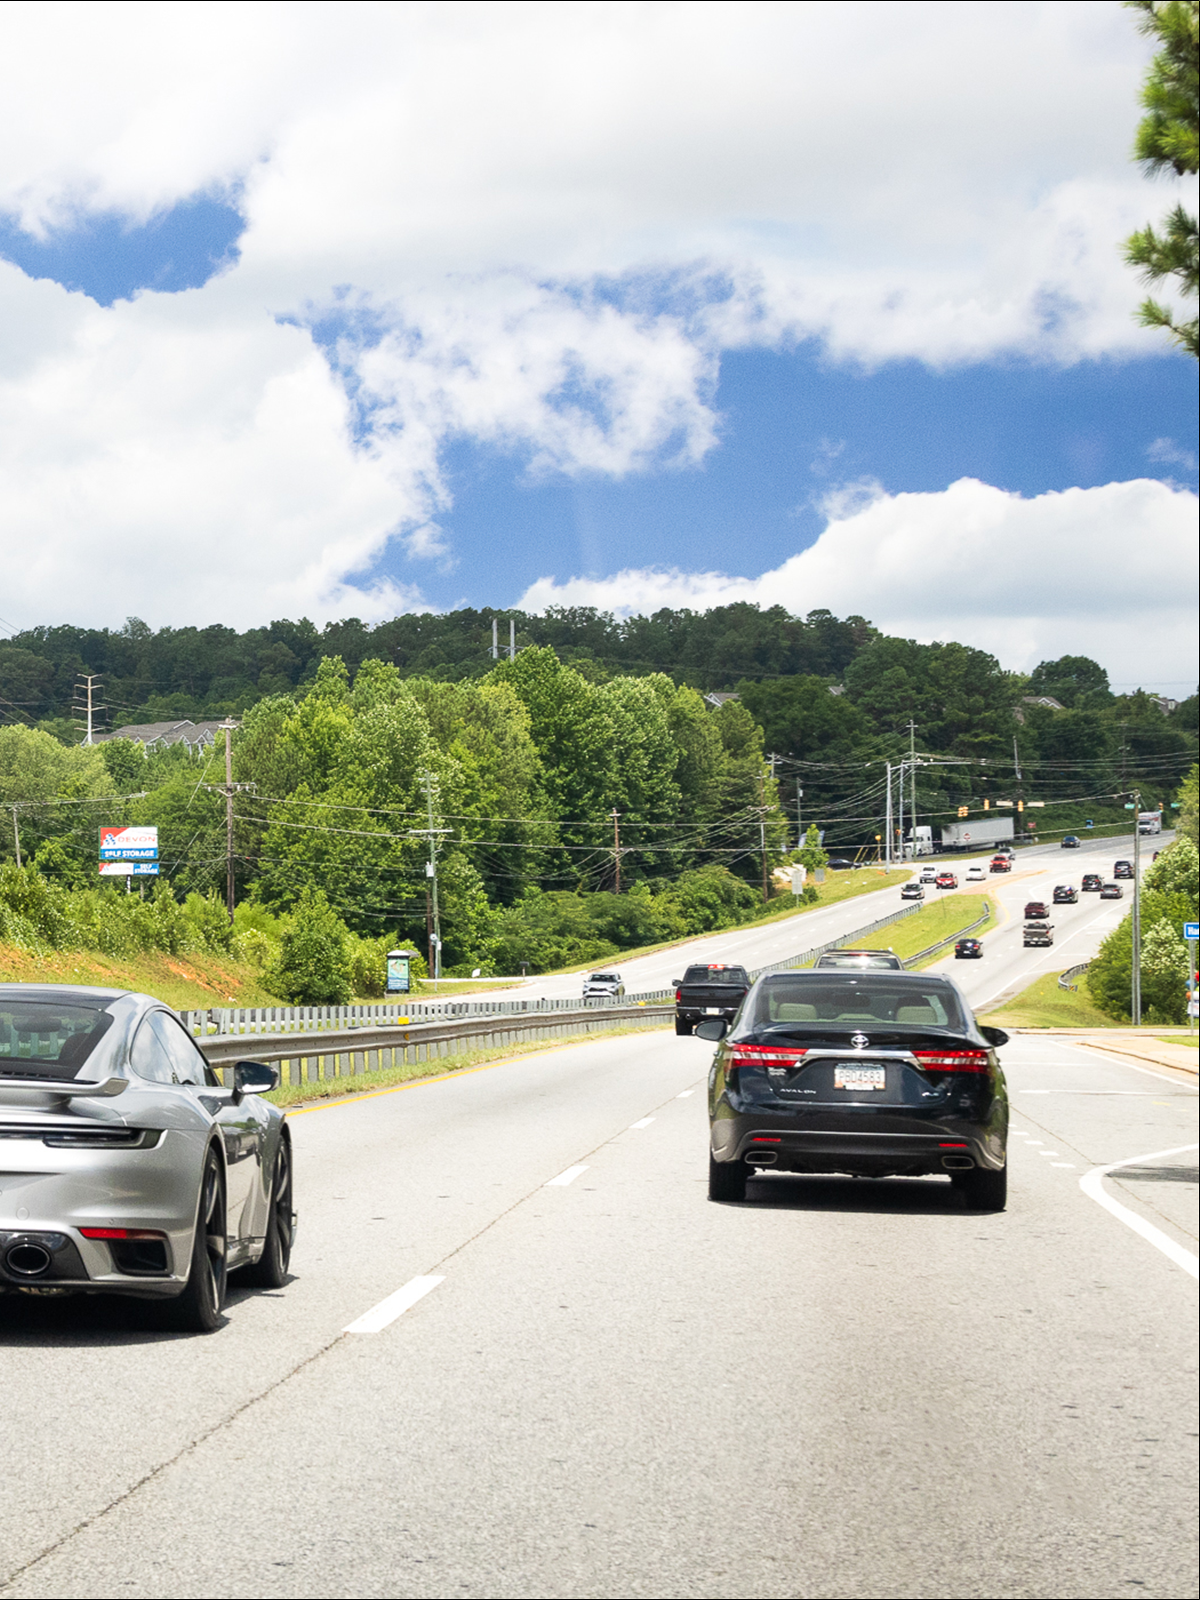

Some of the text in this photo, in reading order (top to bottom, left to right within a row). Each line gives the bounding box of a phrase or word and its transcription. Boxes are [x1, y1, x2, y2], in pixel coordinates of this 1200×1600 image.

[117, 835, 156, 843] DEVON
[104, 850, 155, 858] SELF STORAGE
